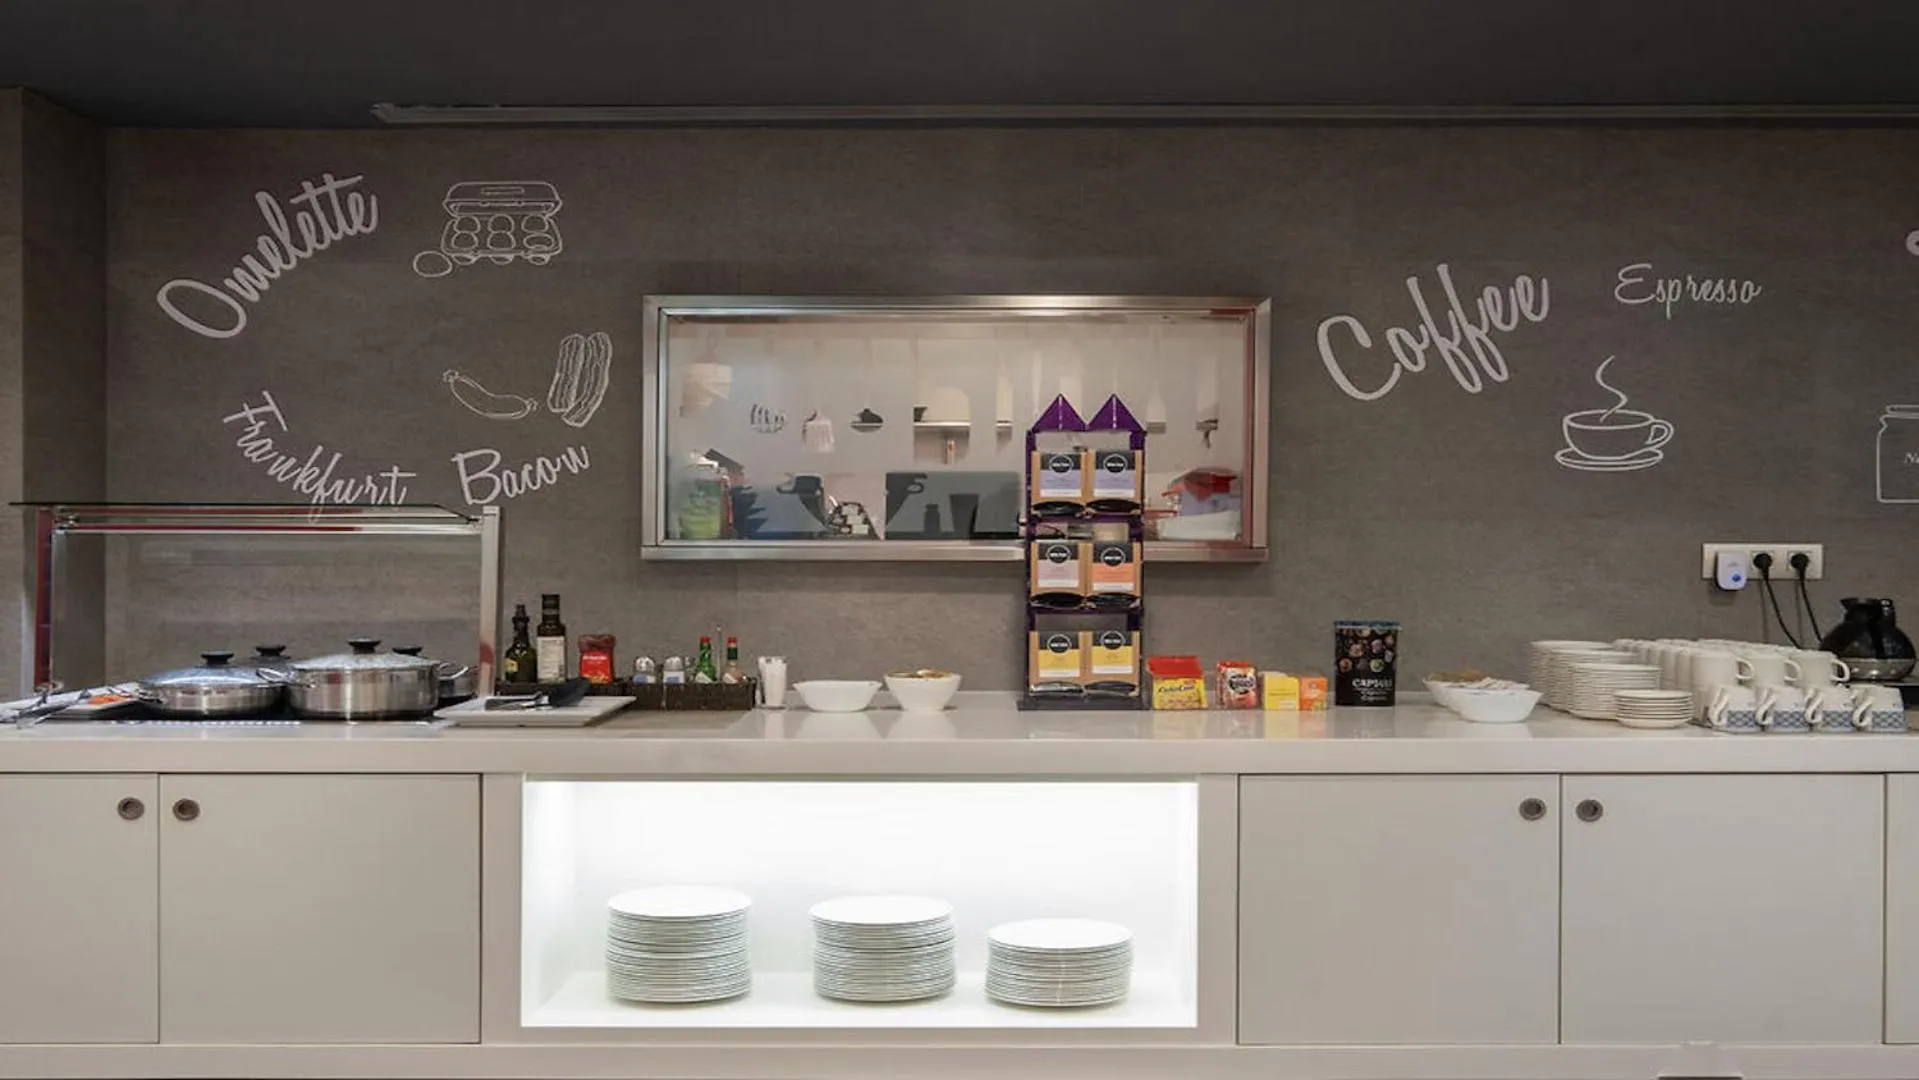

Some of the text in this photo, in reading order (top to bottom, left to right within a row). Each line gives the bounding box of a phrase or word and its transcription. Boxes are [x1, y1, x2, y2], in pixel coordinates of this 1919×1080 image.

[156, 173, 379, 339] Omelette
[1615, 263, 1762, 319] Espresso
[1316, 263, 1550, 401] Coffee
[222, 390, 417, 524] Frankfurt
[451, 444, 590, 505] Bacon
